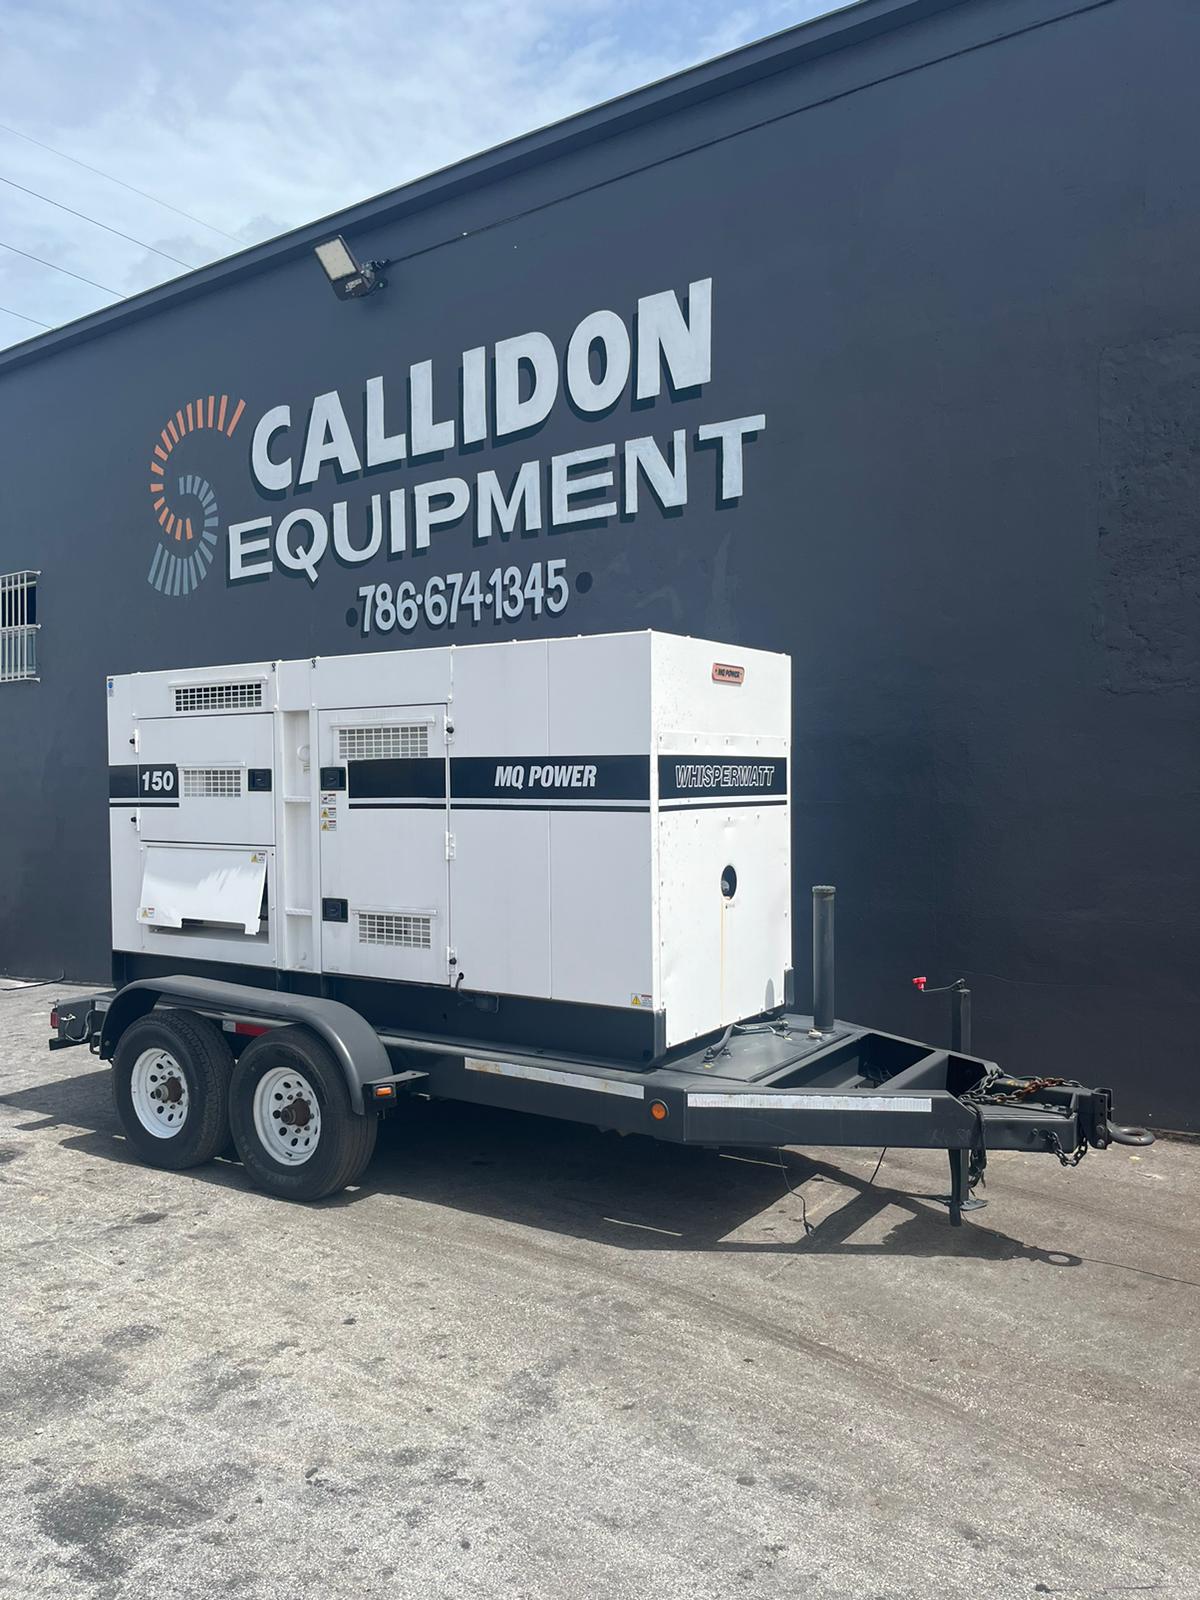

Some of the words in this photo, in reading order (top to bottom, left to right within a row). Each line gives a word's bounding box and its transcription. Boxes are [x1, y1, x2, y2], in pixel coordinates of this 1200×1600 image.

[251, 277, 712, 491] CALLIDON
[228, 414, 766, 582] EQUIPMENT
[142, 770, 174, 791] 150
[494, 765, 525, 790] MQ
[528, 765, 597, 787] POWER
[675, 764, 775, 788] WHISPERWATT
